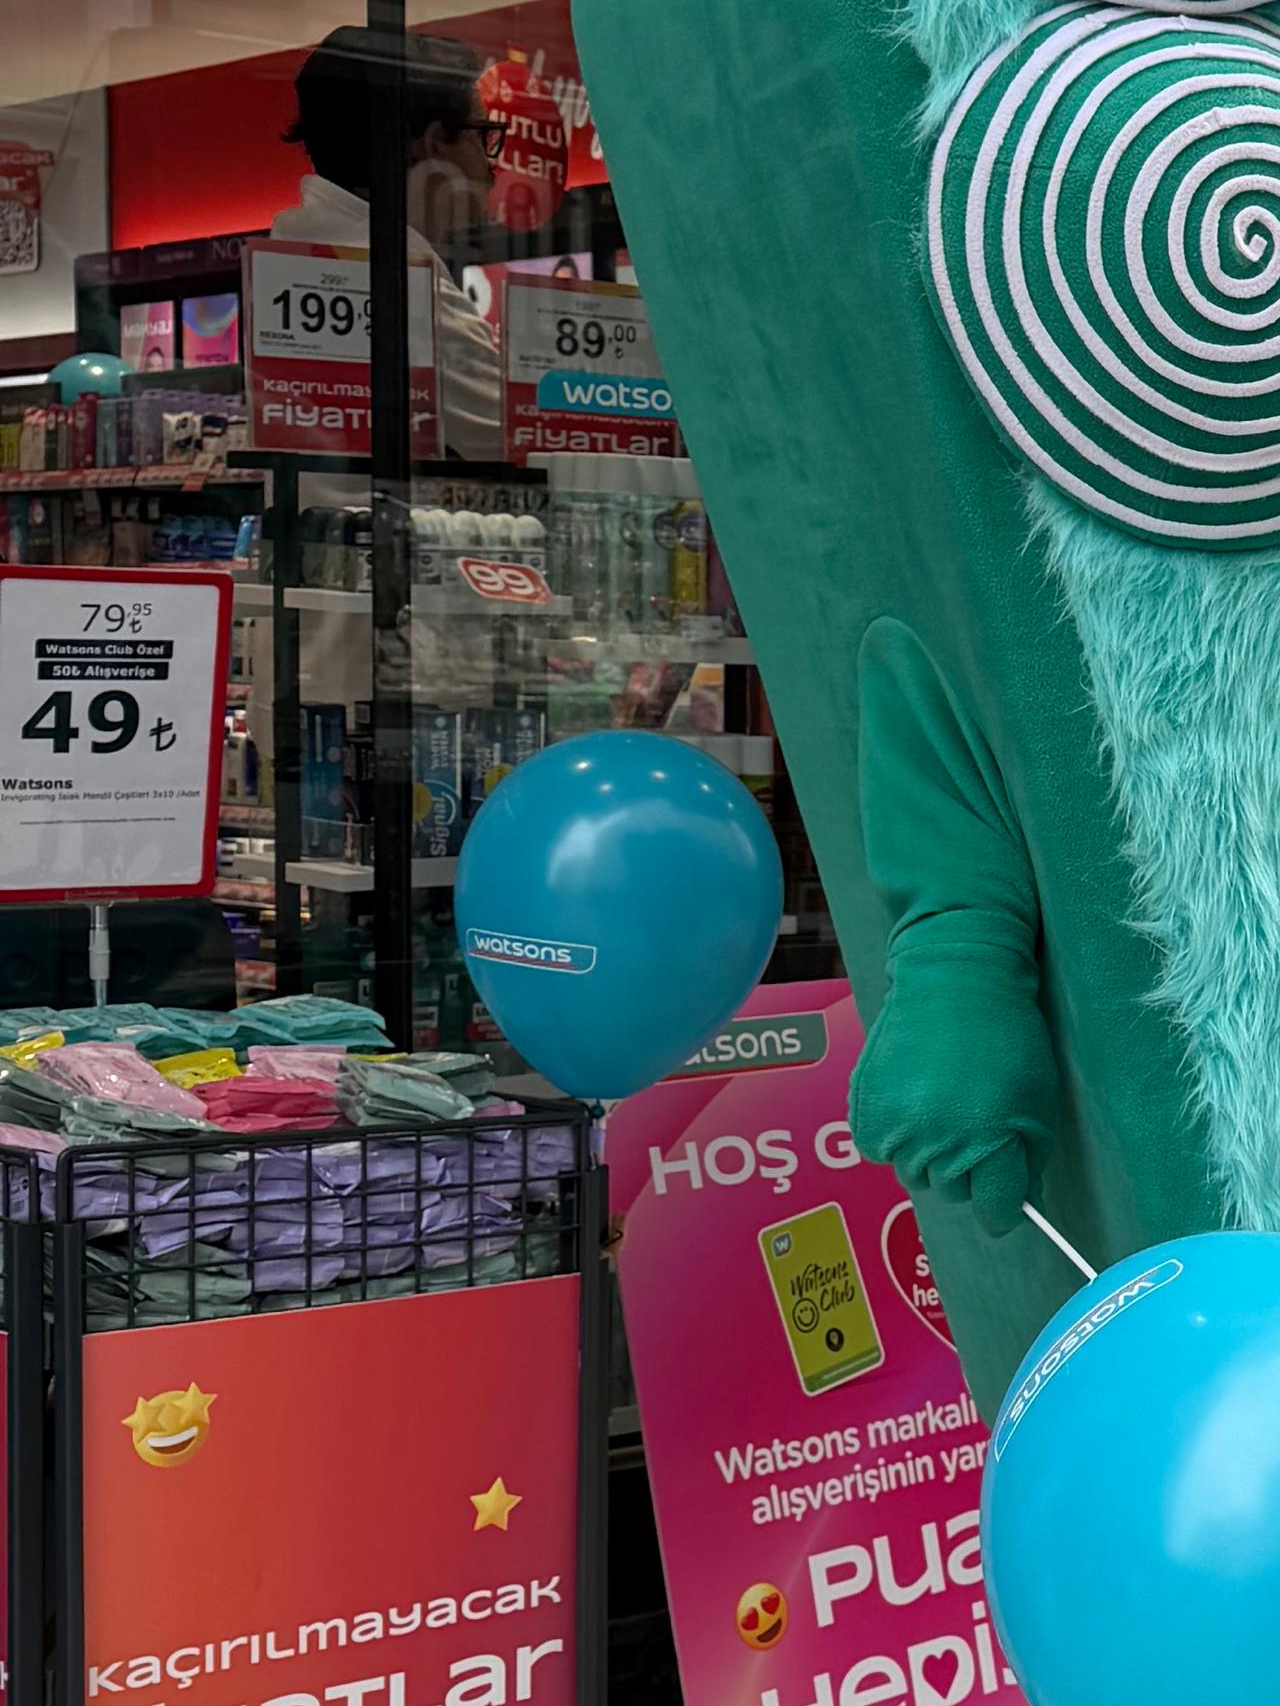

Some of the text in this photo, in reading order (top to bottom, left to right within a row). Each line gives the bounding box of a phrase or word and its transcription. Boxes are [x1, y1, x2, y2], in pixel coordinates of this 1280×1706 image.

[563, 381, 673, 411] watso
[469, 564, 536, 594] 99
[80, 603, 152, 633] 79,95
[46, 643, 164, 655] Watsons Club Özel
[84, 665, 155, 679] Alışverişe
[22, 690, 140, 754] 49
[1, 778, 73, 791] Watsons
[430, 791, 450, 856] Signal
[474, 935, 572, 963] watsons
[648, 1121, 861, 1195] HOŞ G
[912, 1284, 939, 1307] he
[1010, 1279, 1155, 1421] watsons
[714, 1392, 978, 1484] Watsons markalı
[751, 1438, 990, 1525] alışverişinin yar
[808, 1509, 984, 1628] Pua
